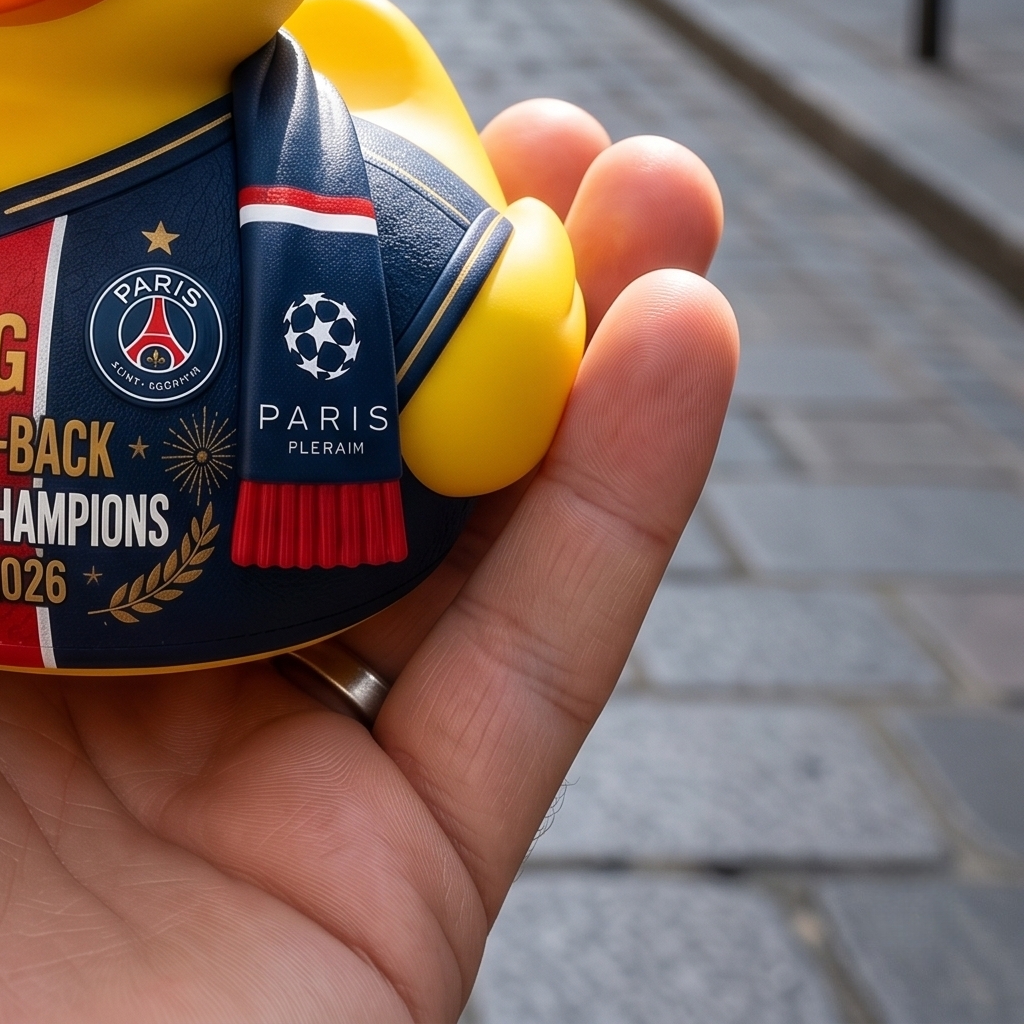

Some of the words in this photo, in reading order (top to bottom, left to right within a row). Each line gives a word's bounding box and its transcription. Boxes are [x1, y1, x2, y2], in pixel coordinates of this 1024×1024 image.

[113, 274, 202, 308] PARIS
[259, 404, 388, 431] PARIS
[288, 441, 364, 454] PLERAIM
